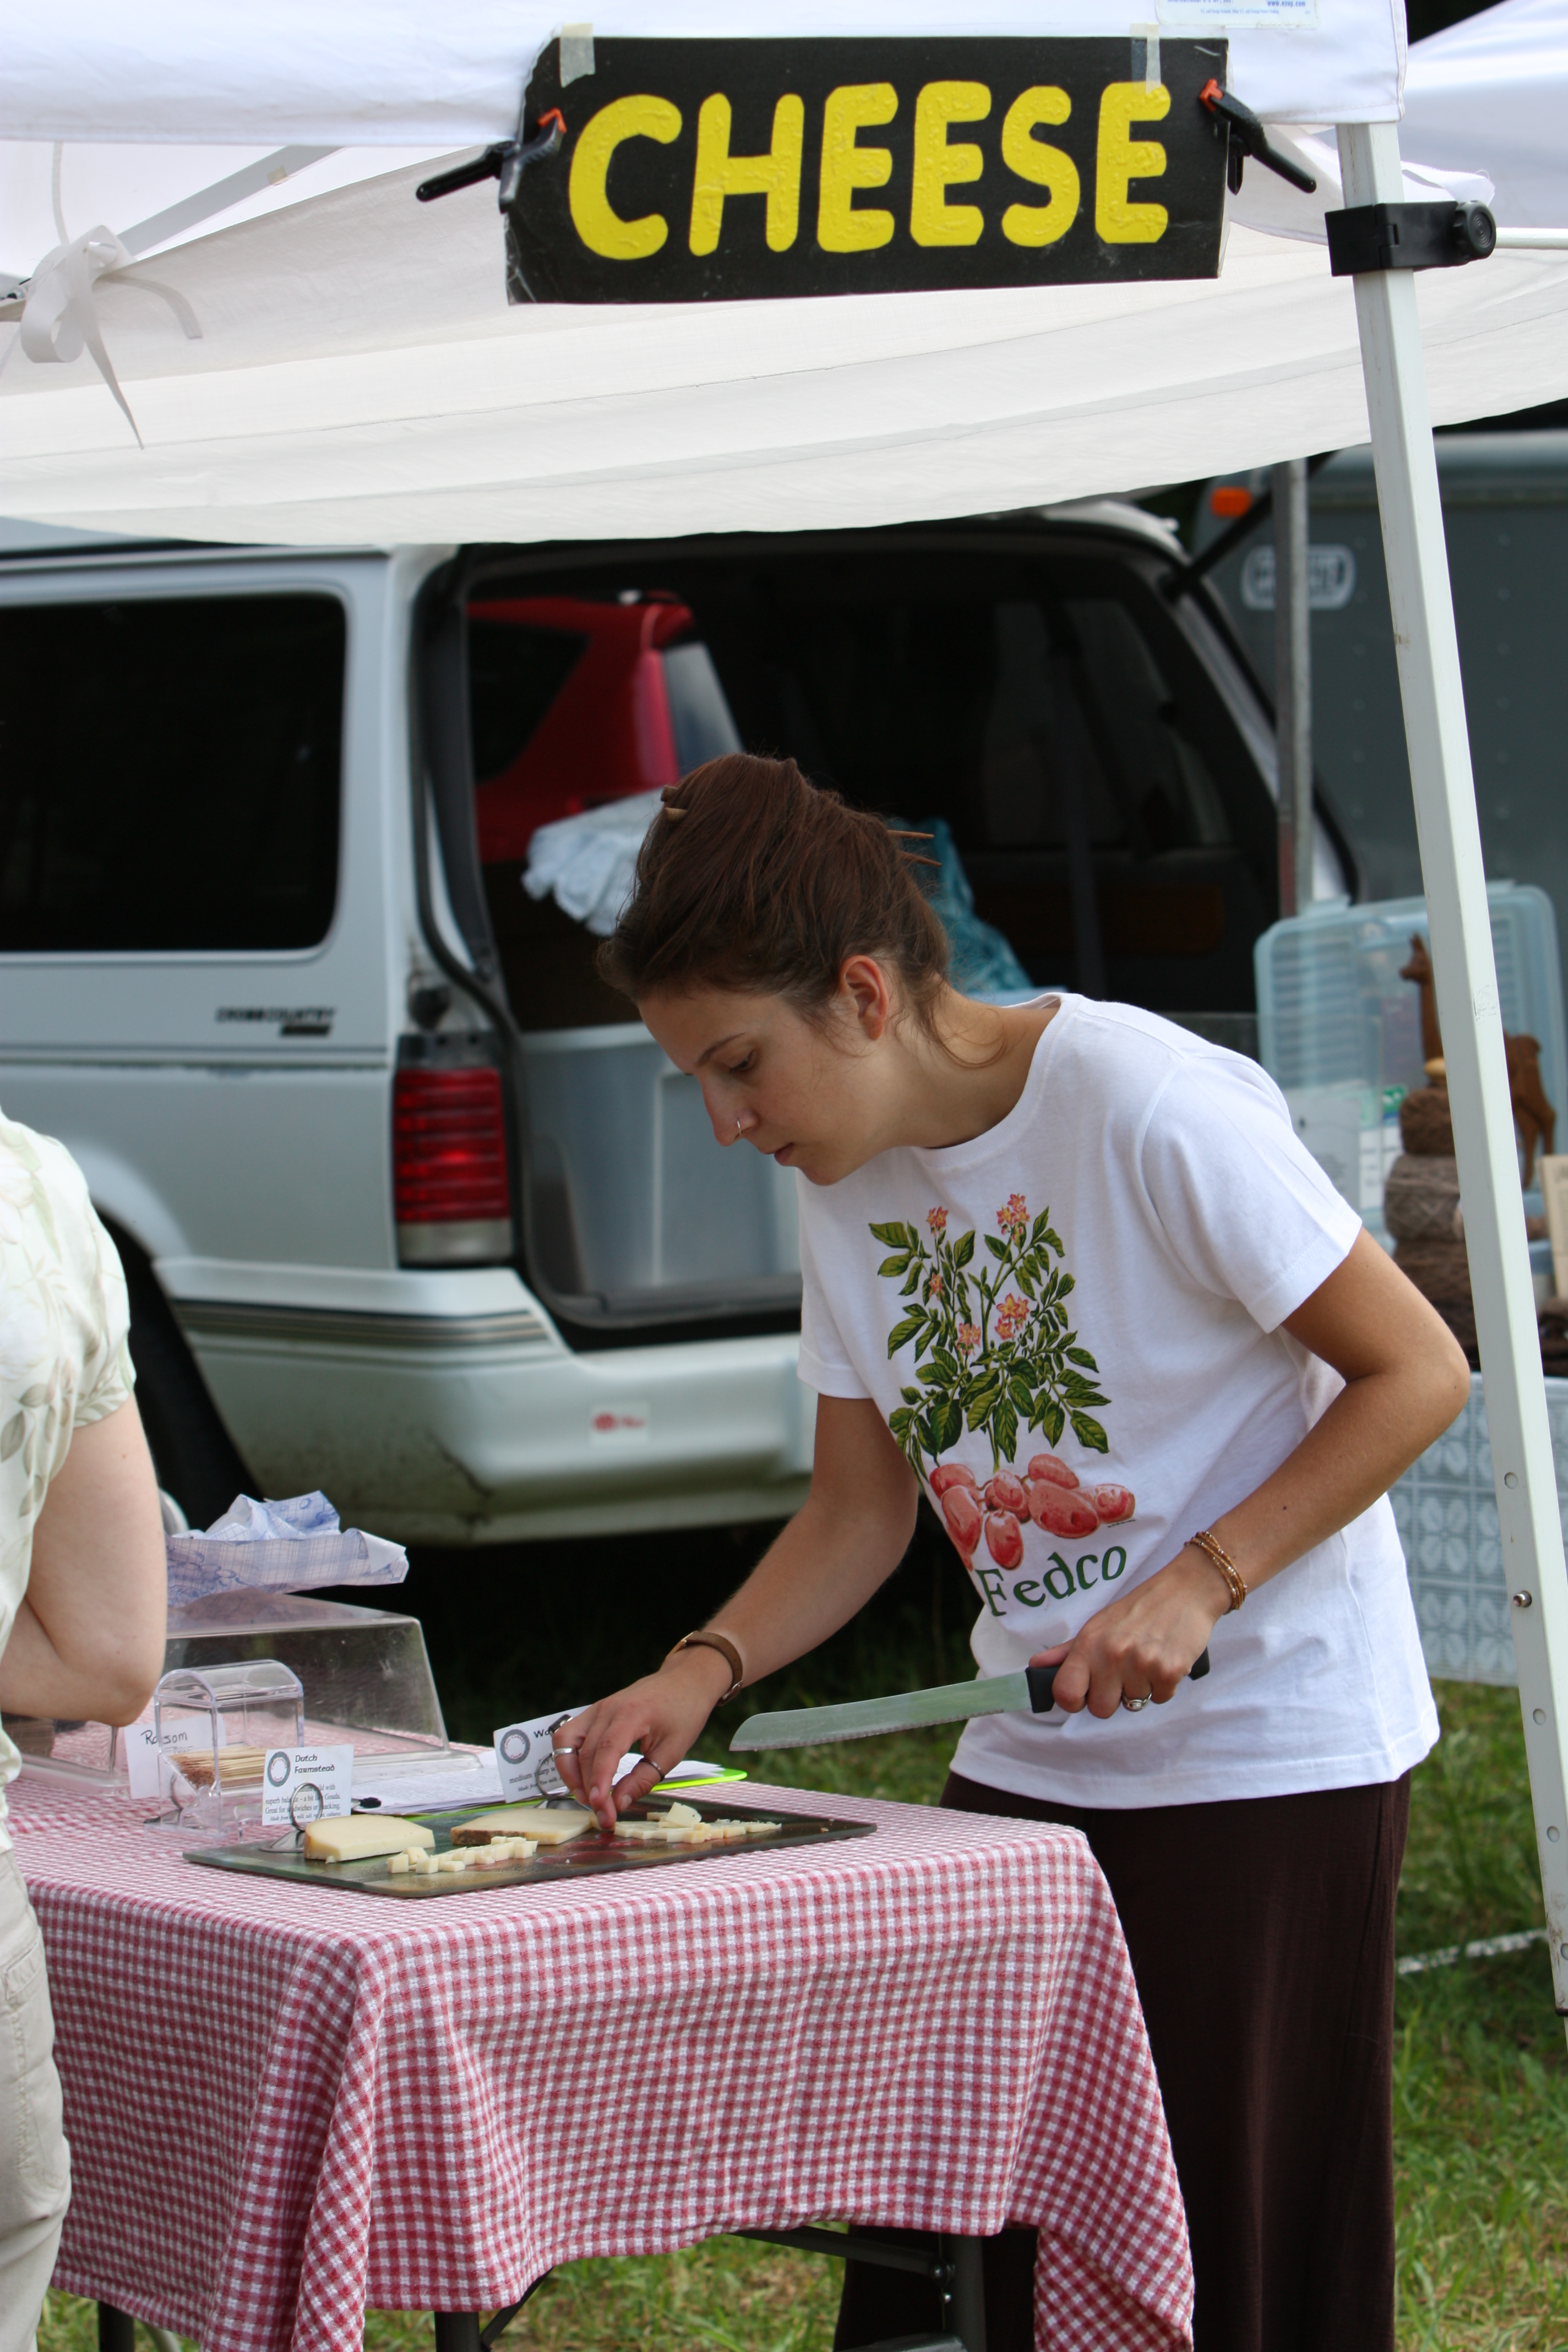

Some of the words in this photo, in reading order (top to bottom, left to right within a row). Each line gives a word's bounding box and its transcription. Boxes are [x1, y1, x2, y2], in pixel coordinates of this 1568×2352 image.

[568, 80, 1171, 260] CHEESE
[974, 1546, 1126, 1616] Fedco
[295, 1754, 318, 1762] Dutch
[295, 1765, 335, 1773] Farmstead
[509, 1773, 532, 1784] medium
[534, 1768, 549, 1777] sarp
[265, 1797, 280, 1805] superb
